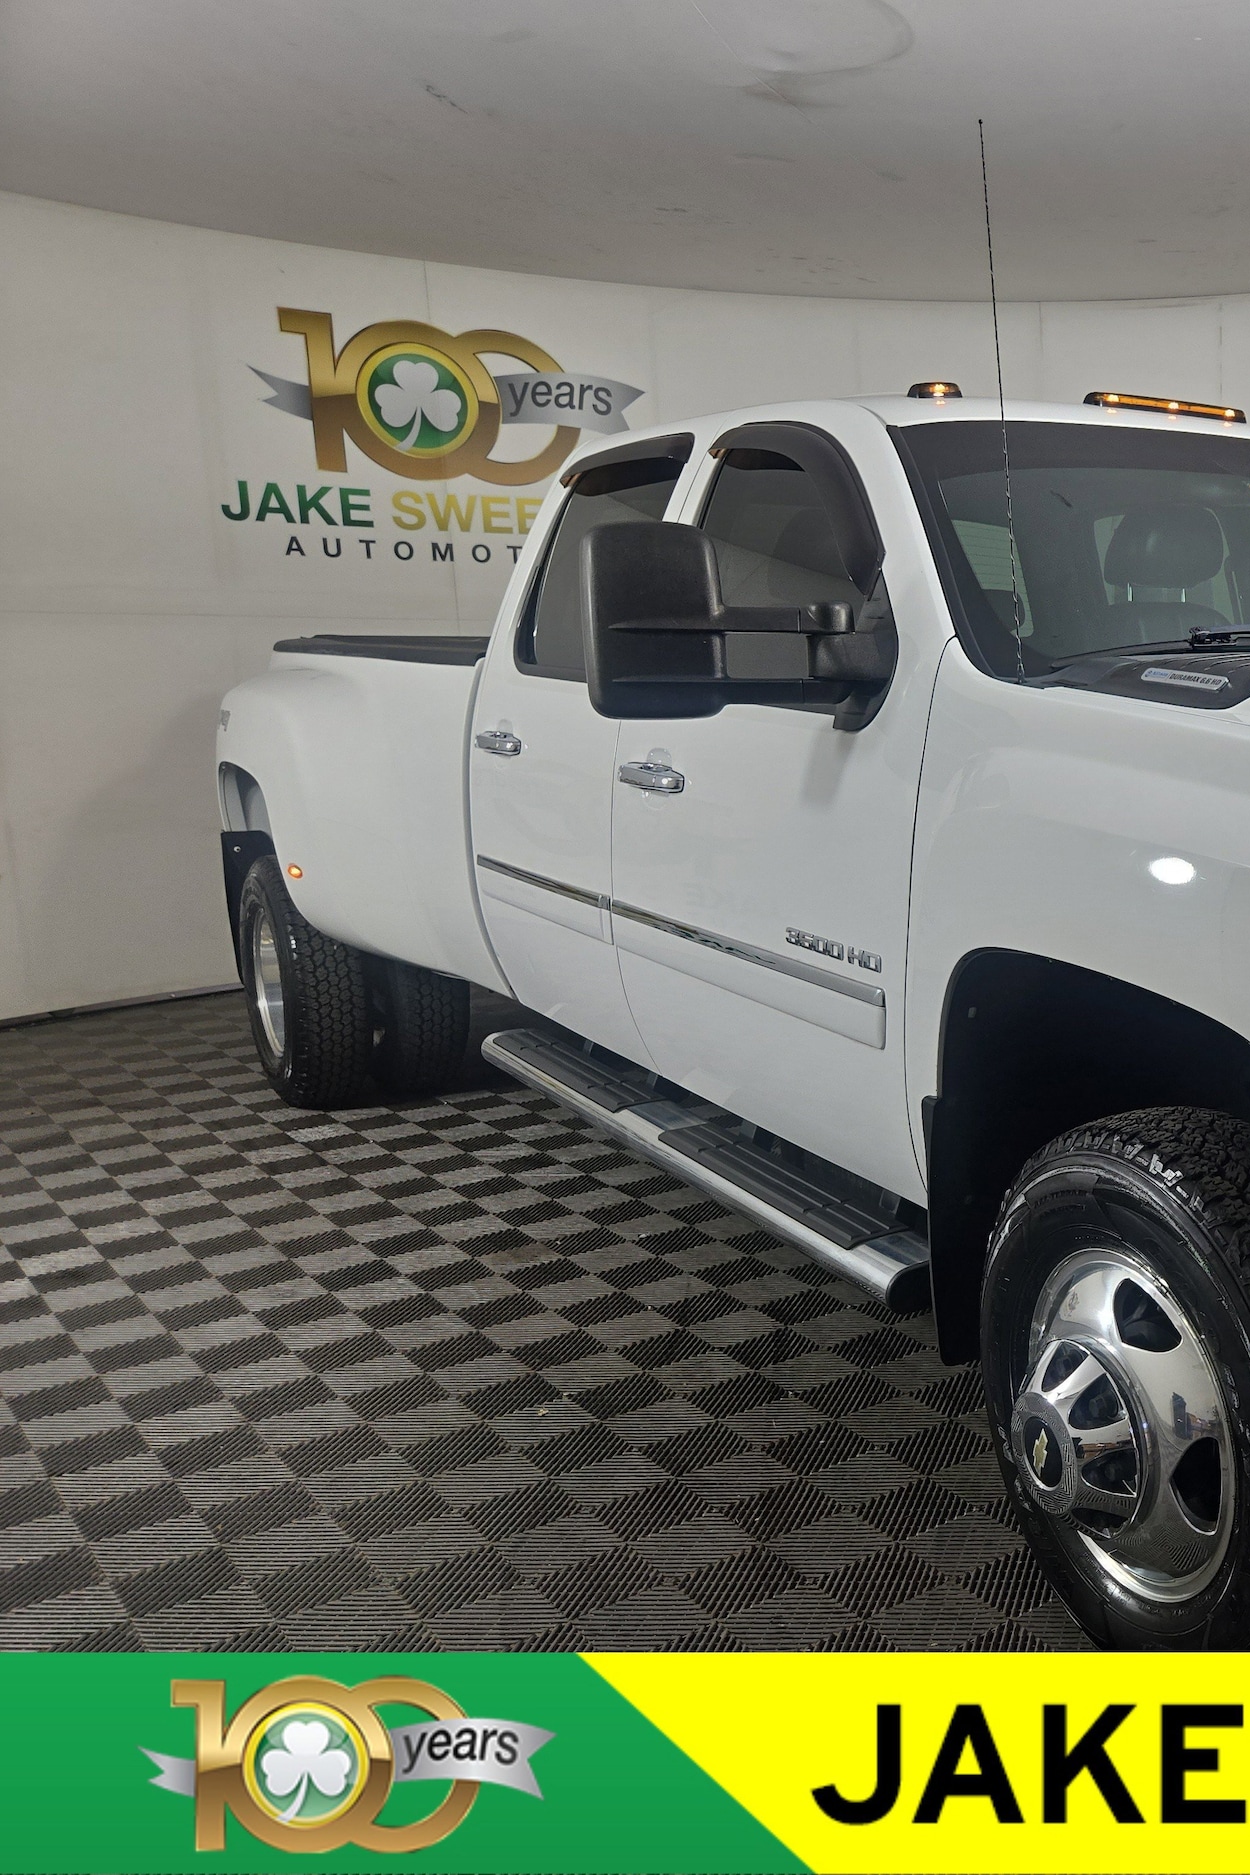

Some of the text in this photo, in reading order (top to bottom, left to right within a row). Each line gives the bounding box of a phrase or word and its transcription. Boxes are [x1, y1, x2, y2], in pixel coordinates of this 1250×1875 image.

[507, 379, 613, 416] years
[220, 480, 375, 529] JAKE
[1169, 673, 1200, 683] DURAMAX
[785, 926, 882, 974] 3500 HD
